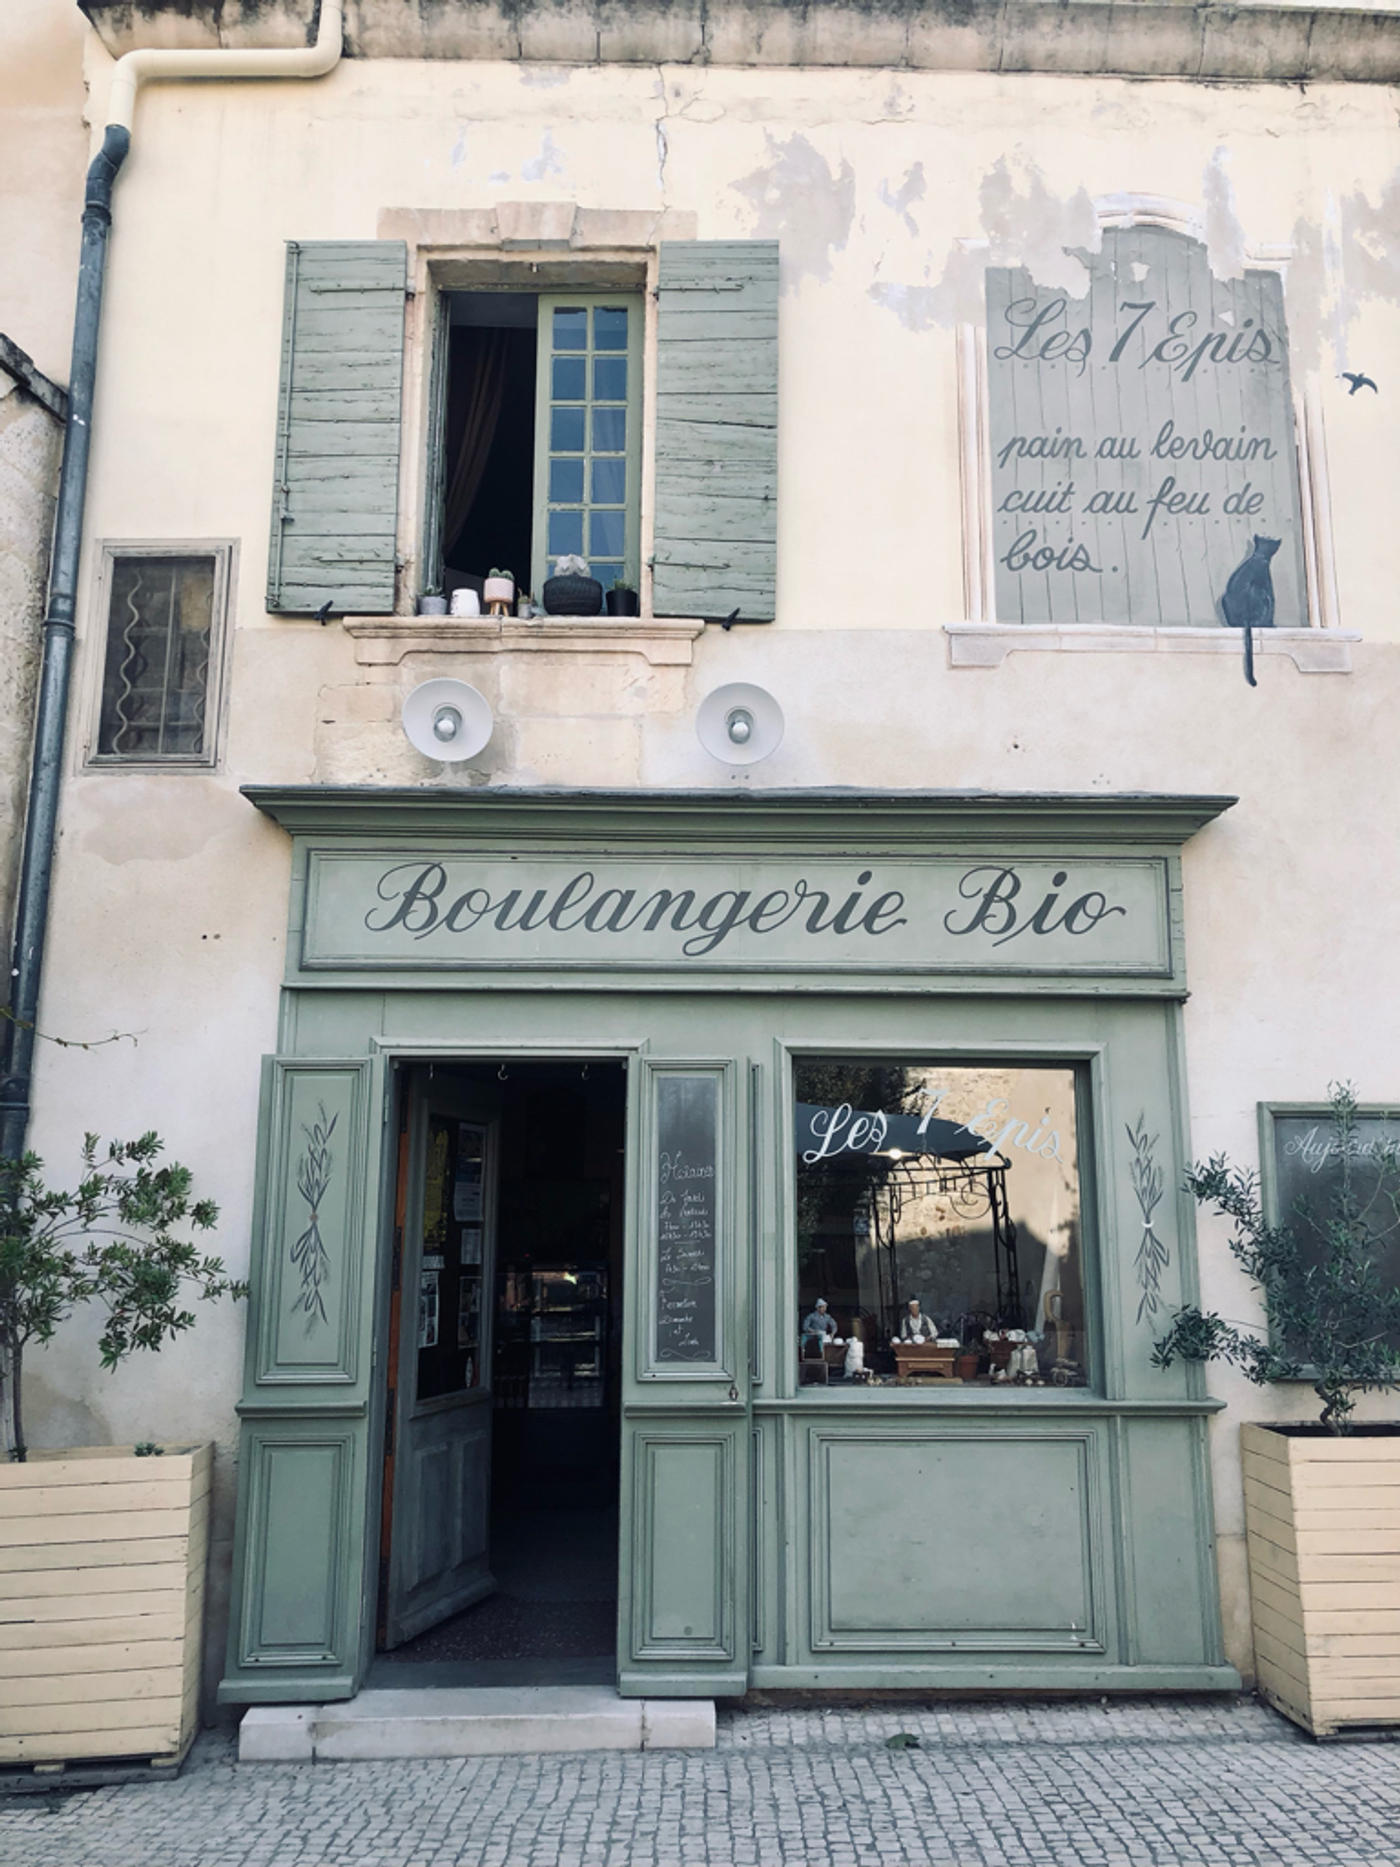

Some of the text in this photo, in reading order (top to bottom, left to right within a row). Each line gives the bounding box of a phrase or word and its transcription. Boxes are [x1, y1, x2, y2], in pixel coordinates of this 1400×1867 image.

[993, 297, 1280, 382] Les 7 Epis
[998, 420, 1277, 468] pain au levain
[998, 476, 1264, 540] cuit au feu de
[365, 862, 1126, 956] Boulangerie Bio
[802, 1088, 1063, 1164] Les 7 Epis
